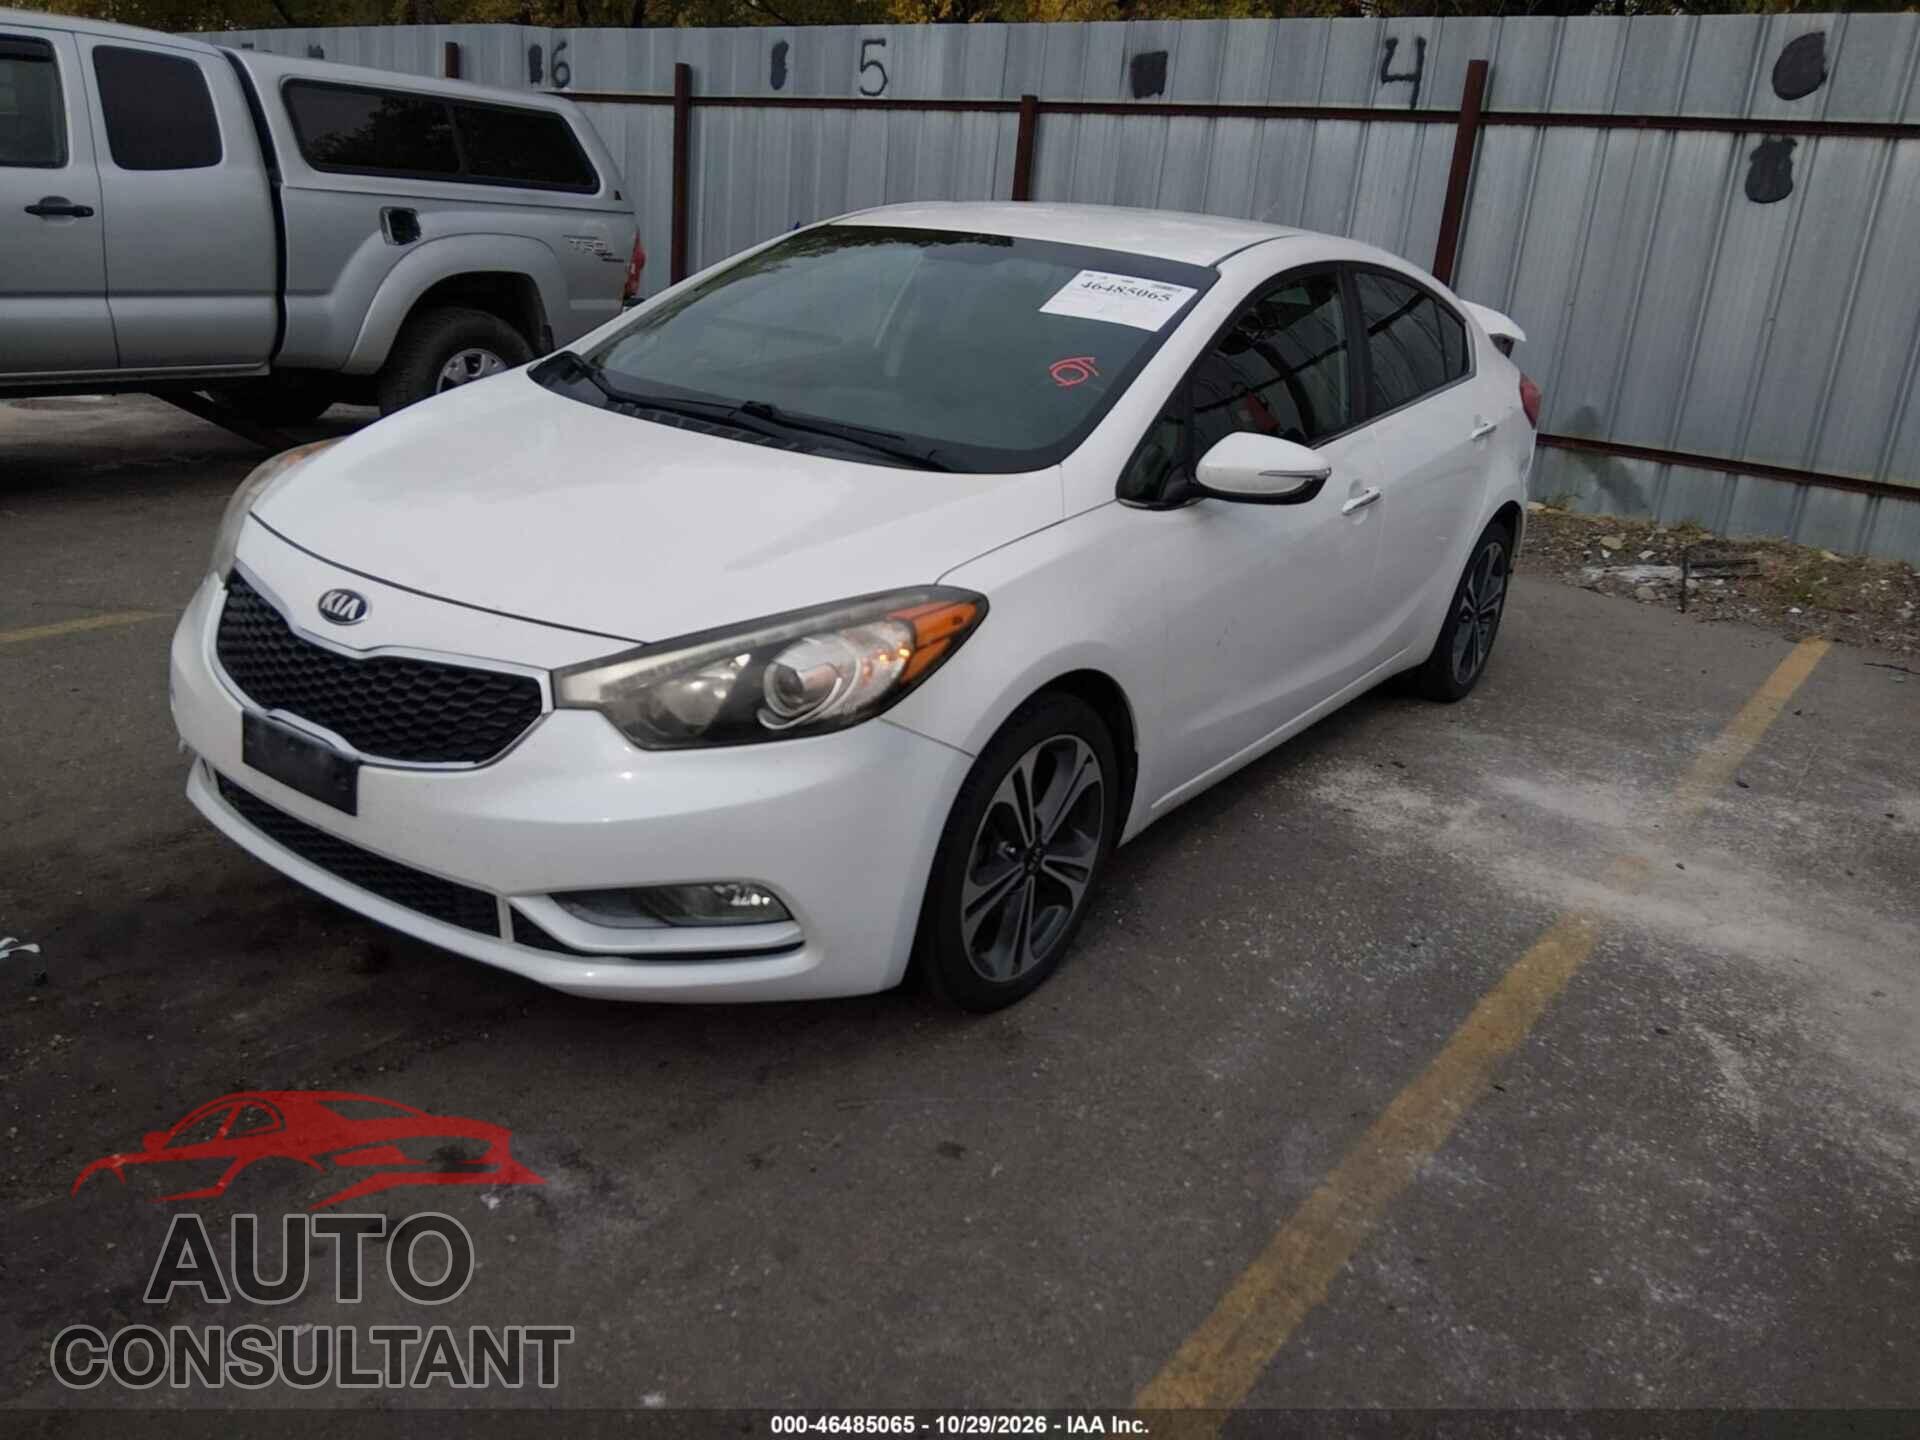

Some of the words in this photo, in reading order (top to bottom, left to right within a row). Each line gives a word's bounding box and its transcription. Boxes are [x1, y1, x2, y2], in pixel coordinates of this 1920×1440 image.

[859, 37, 889, 97] 5
[1380, 36, 1427, 110] 4
[320, 591, 361, 620] KIA
